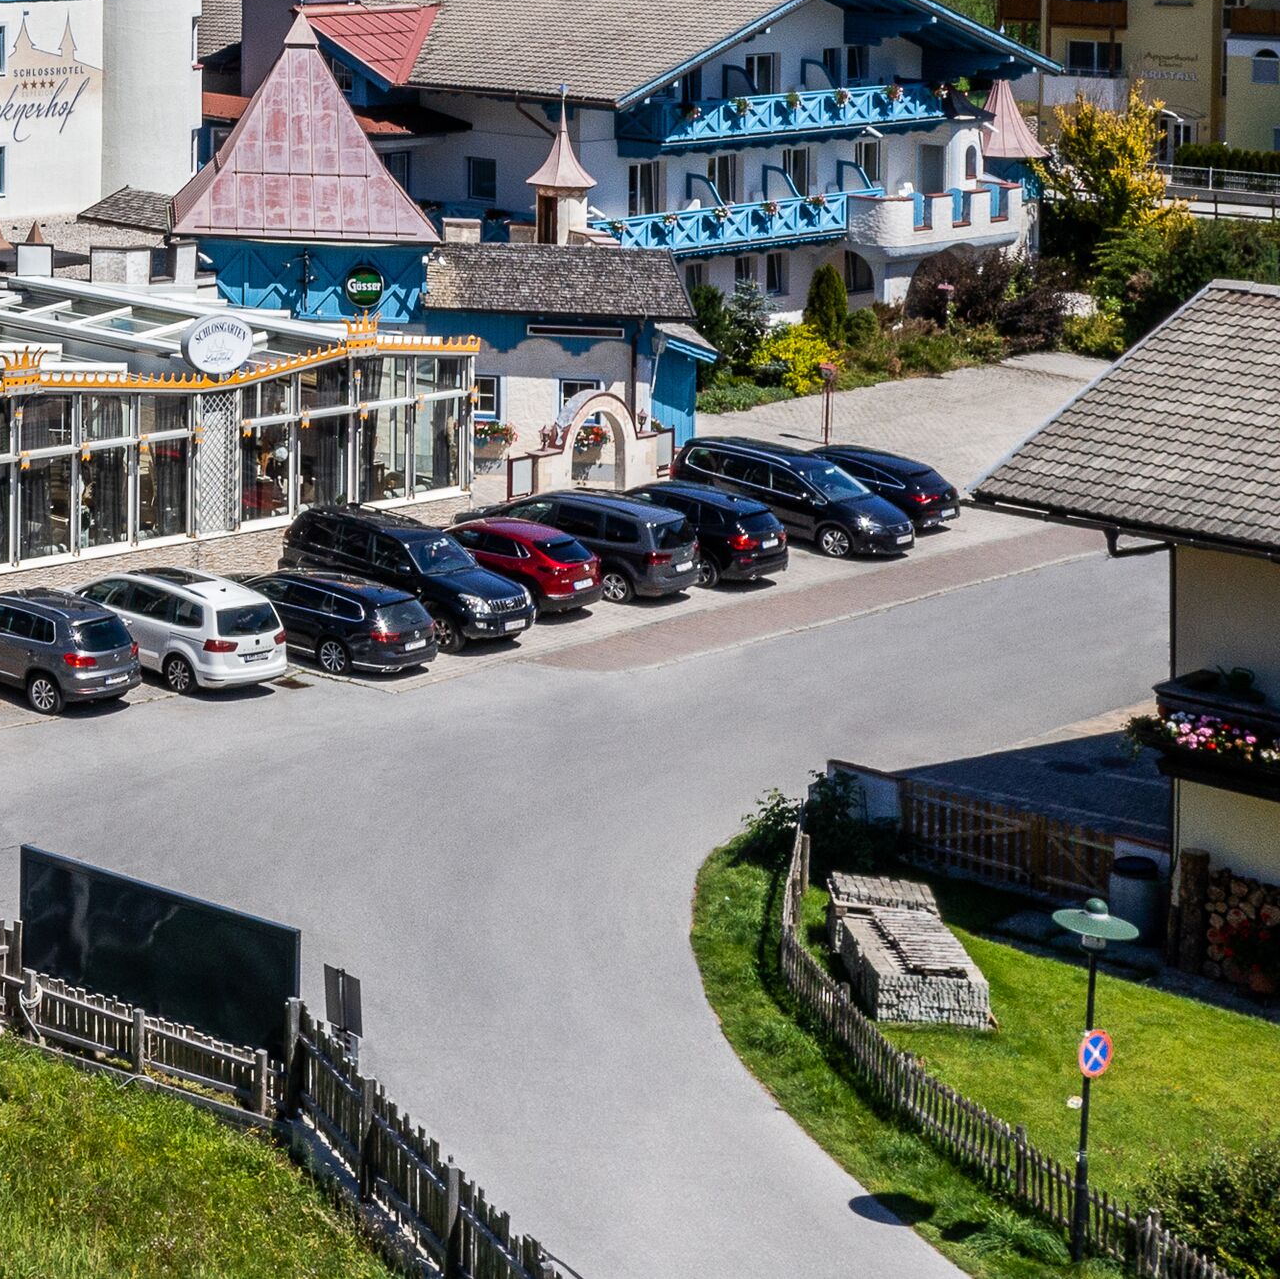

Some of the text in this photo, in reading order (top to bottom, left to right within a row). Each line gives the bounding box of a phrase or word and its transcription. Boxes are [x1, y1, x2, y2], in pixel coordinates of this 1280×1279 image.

[13, 65, 85, 78] SCHLOSSHOTEL
[1140, 69, 1199, 82] KRISTALL
[347, 278, 382, 294] Gösser
[195, 322, 248, 344] SCHLOSSGARTEN
